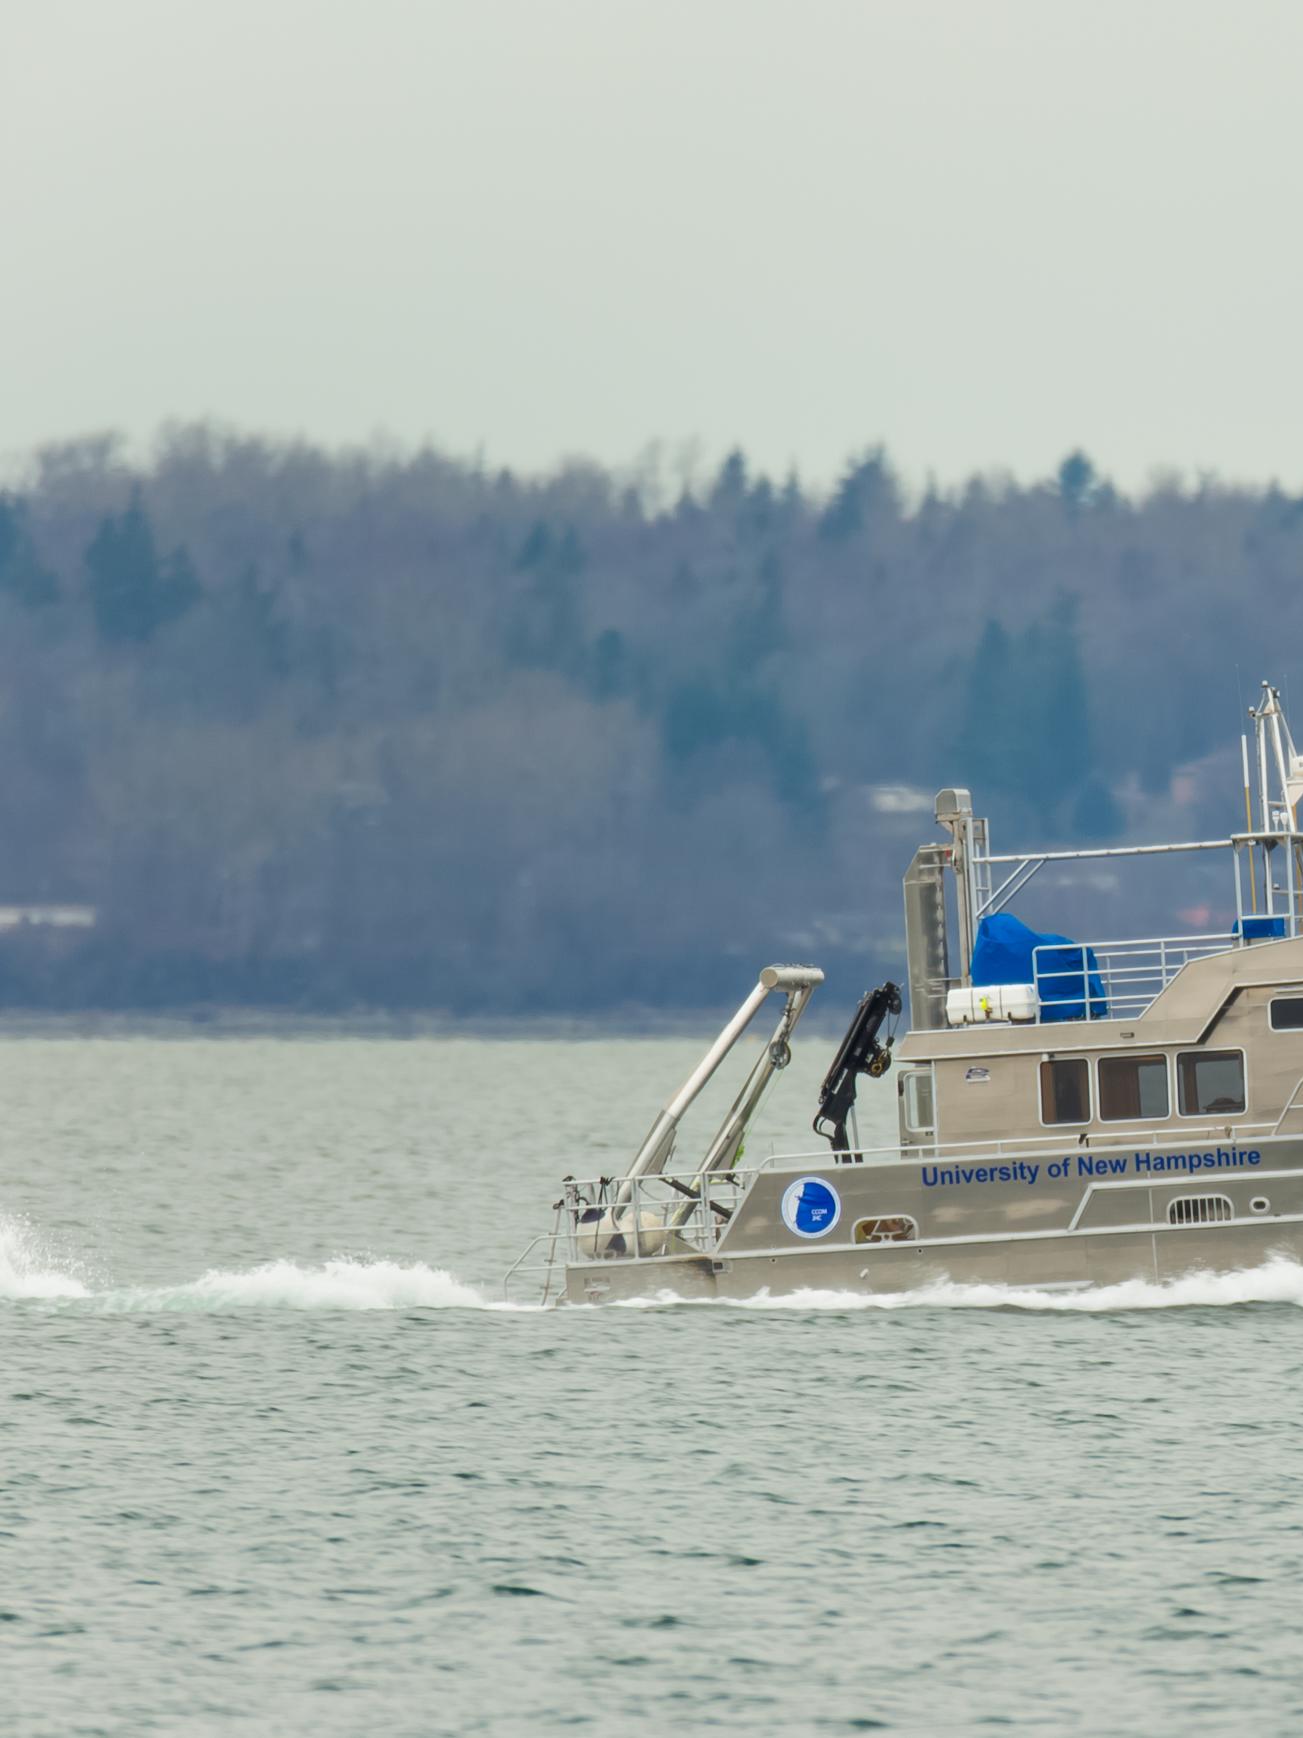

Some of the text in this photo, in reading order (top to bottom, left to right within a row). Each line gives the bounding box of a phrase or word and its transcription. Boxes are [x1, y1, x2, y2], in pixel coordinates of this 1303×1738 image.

[921, 1147, 1261, 1187] University of New Hampshire
